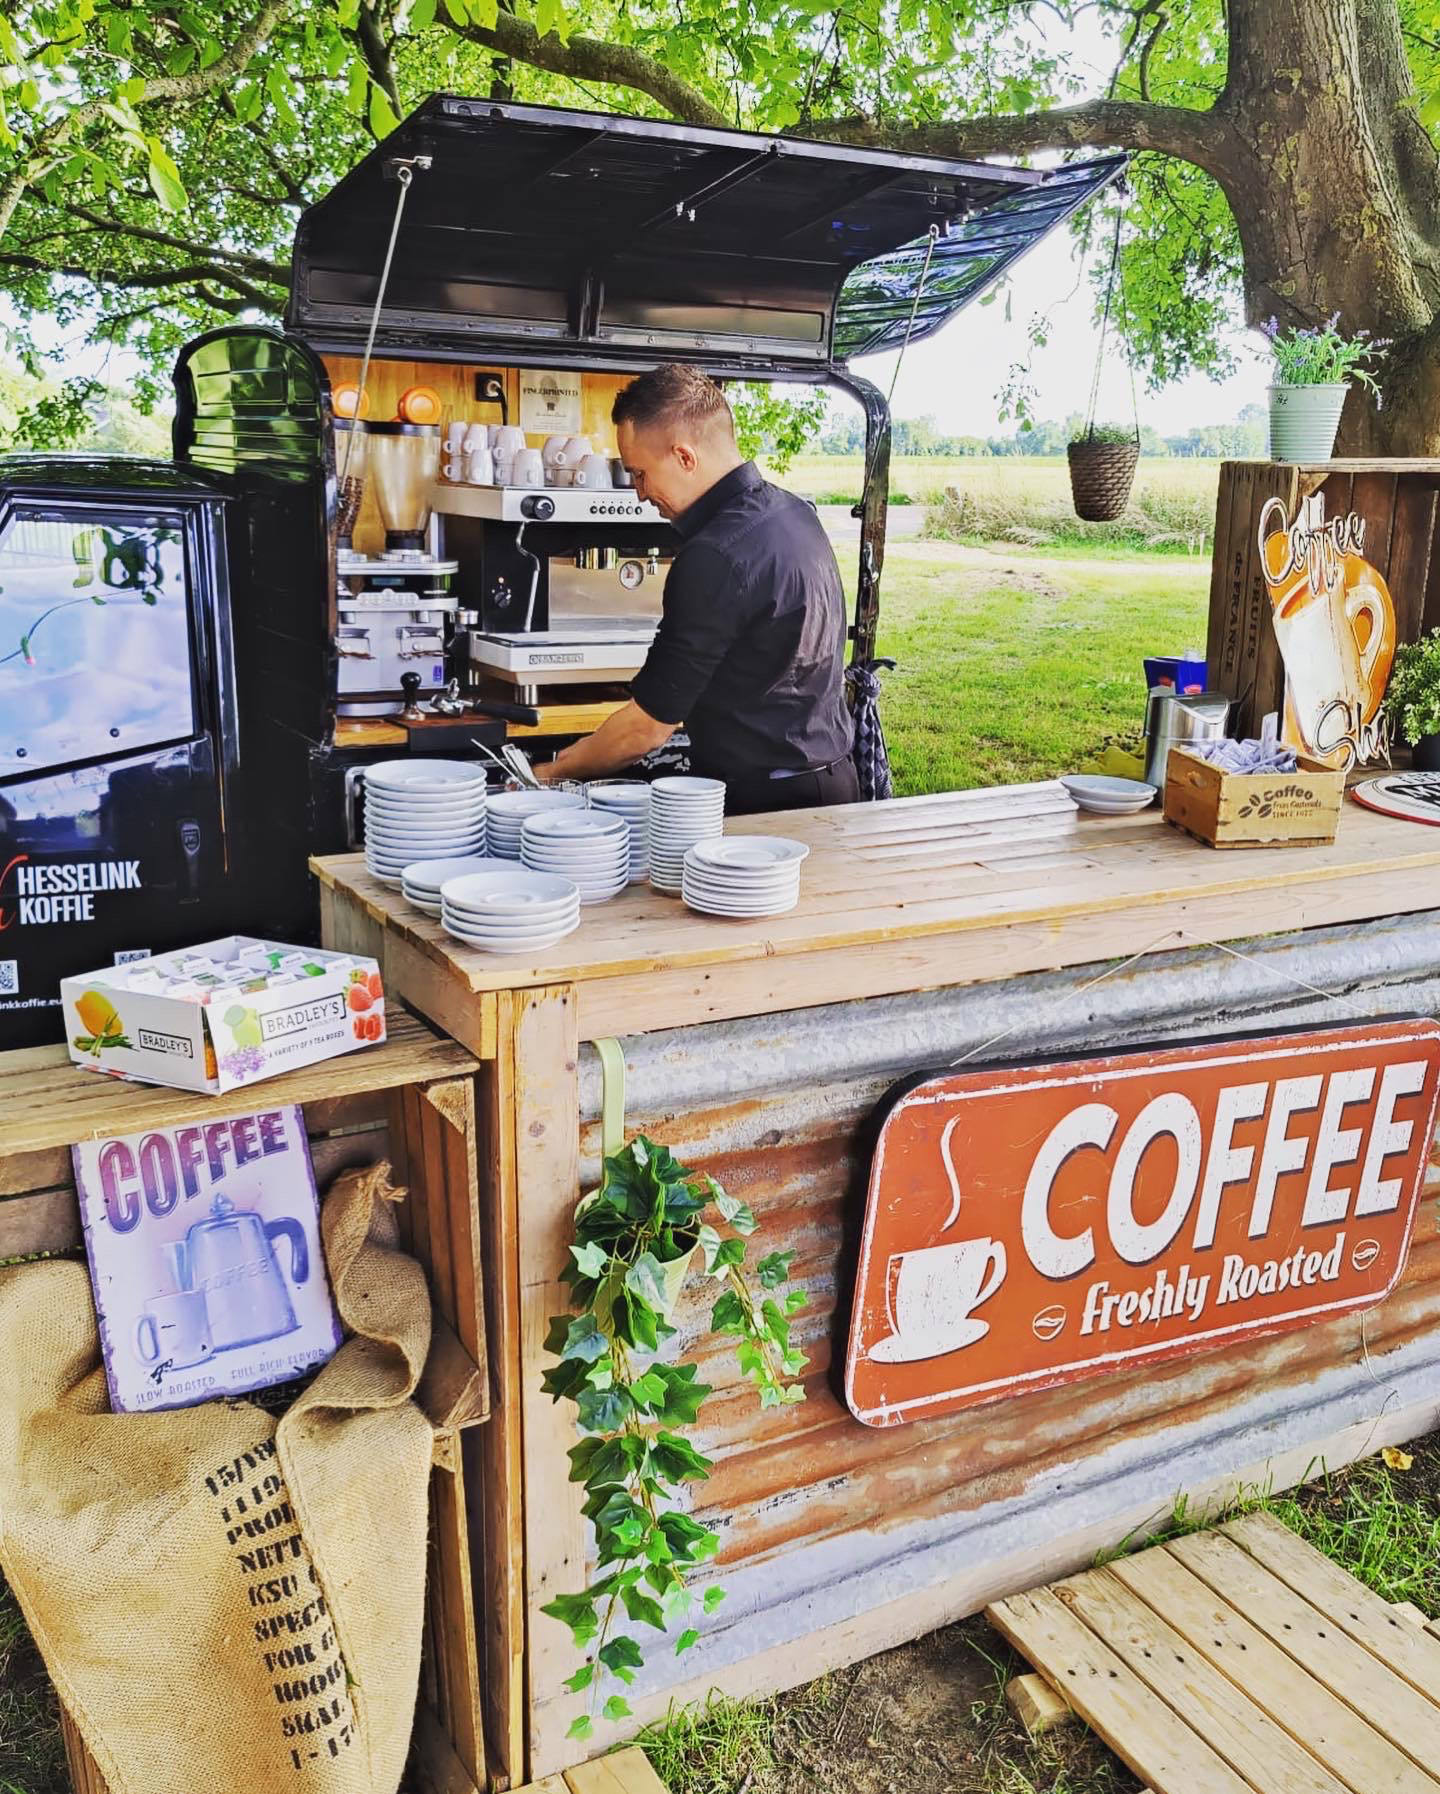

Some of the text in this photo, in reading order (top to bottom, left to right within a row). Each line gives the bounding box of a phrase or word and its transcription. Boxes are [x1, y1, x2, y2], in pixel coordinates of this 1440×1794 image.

[1258, 490, 1366, 598] Coffee
[1224, 581, 1241, 673] FRANCE
[17, 860, 142, 896] HESSELINK
[20, 894, 95, 925] KOFFIE
[274, 1044, 299, 1058] VARIETY
[325, 1030, 345, 1043] BOXES
[99, 1111, 289, 1234] COFFEE
[1021, 1060, 1429, 1282] COFFEE
[1215, 1232, 1347, 1305] Roasted
[136, 1390, 162, 1404] SLOW
[168, 1376, 216, 1398] ROASTED
